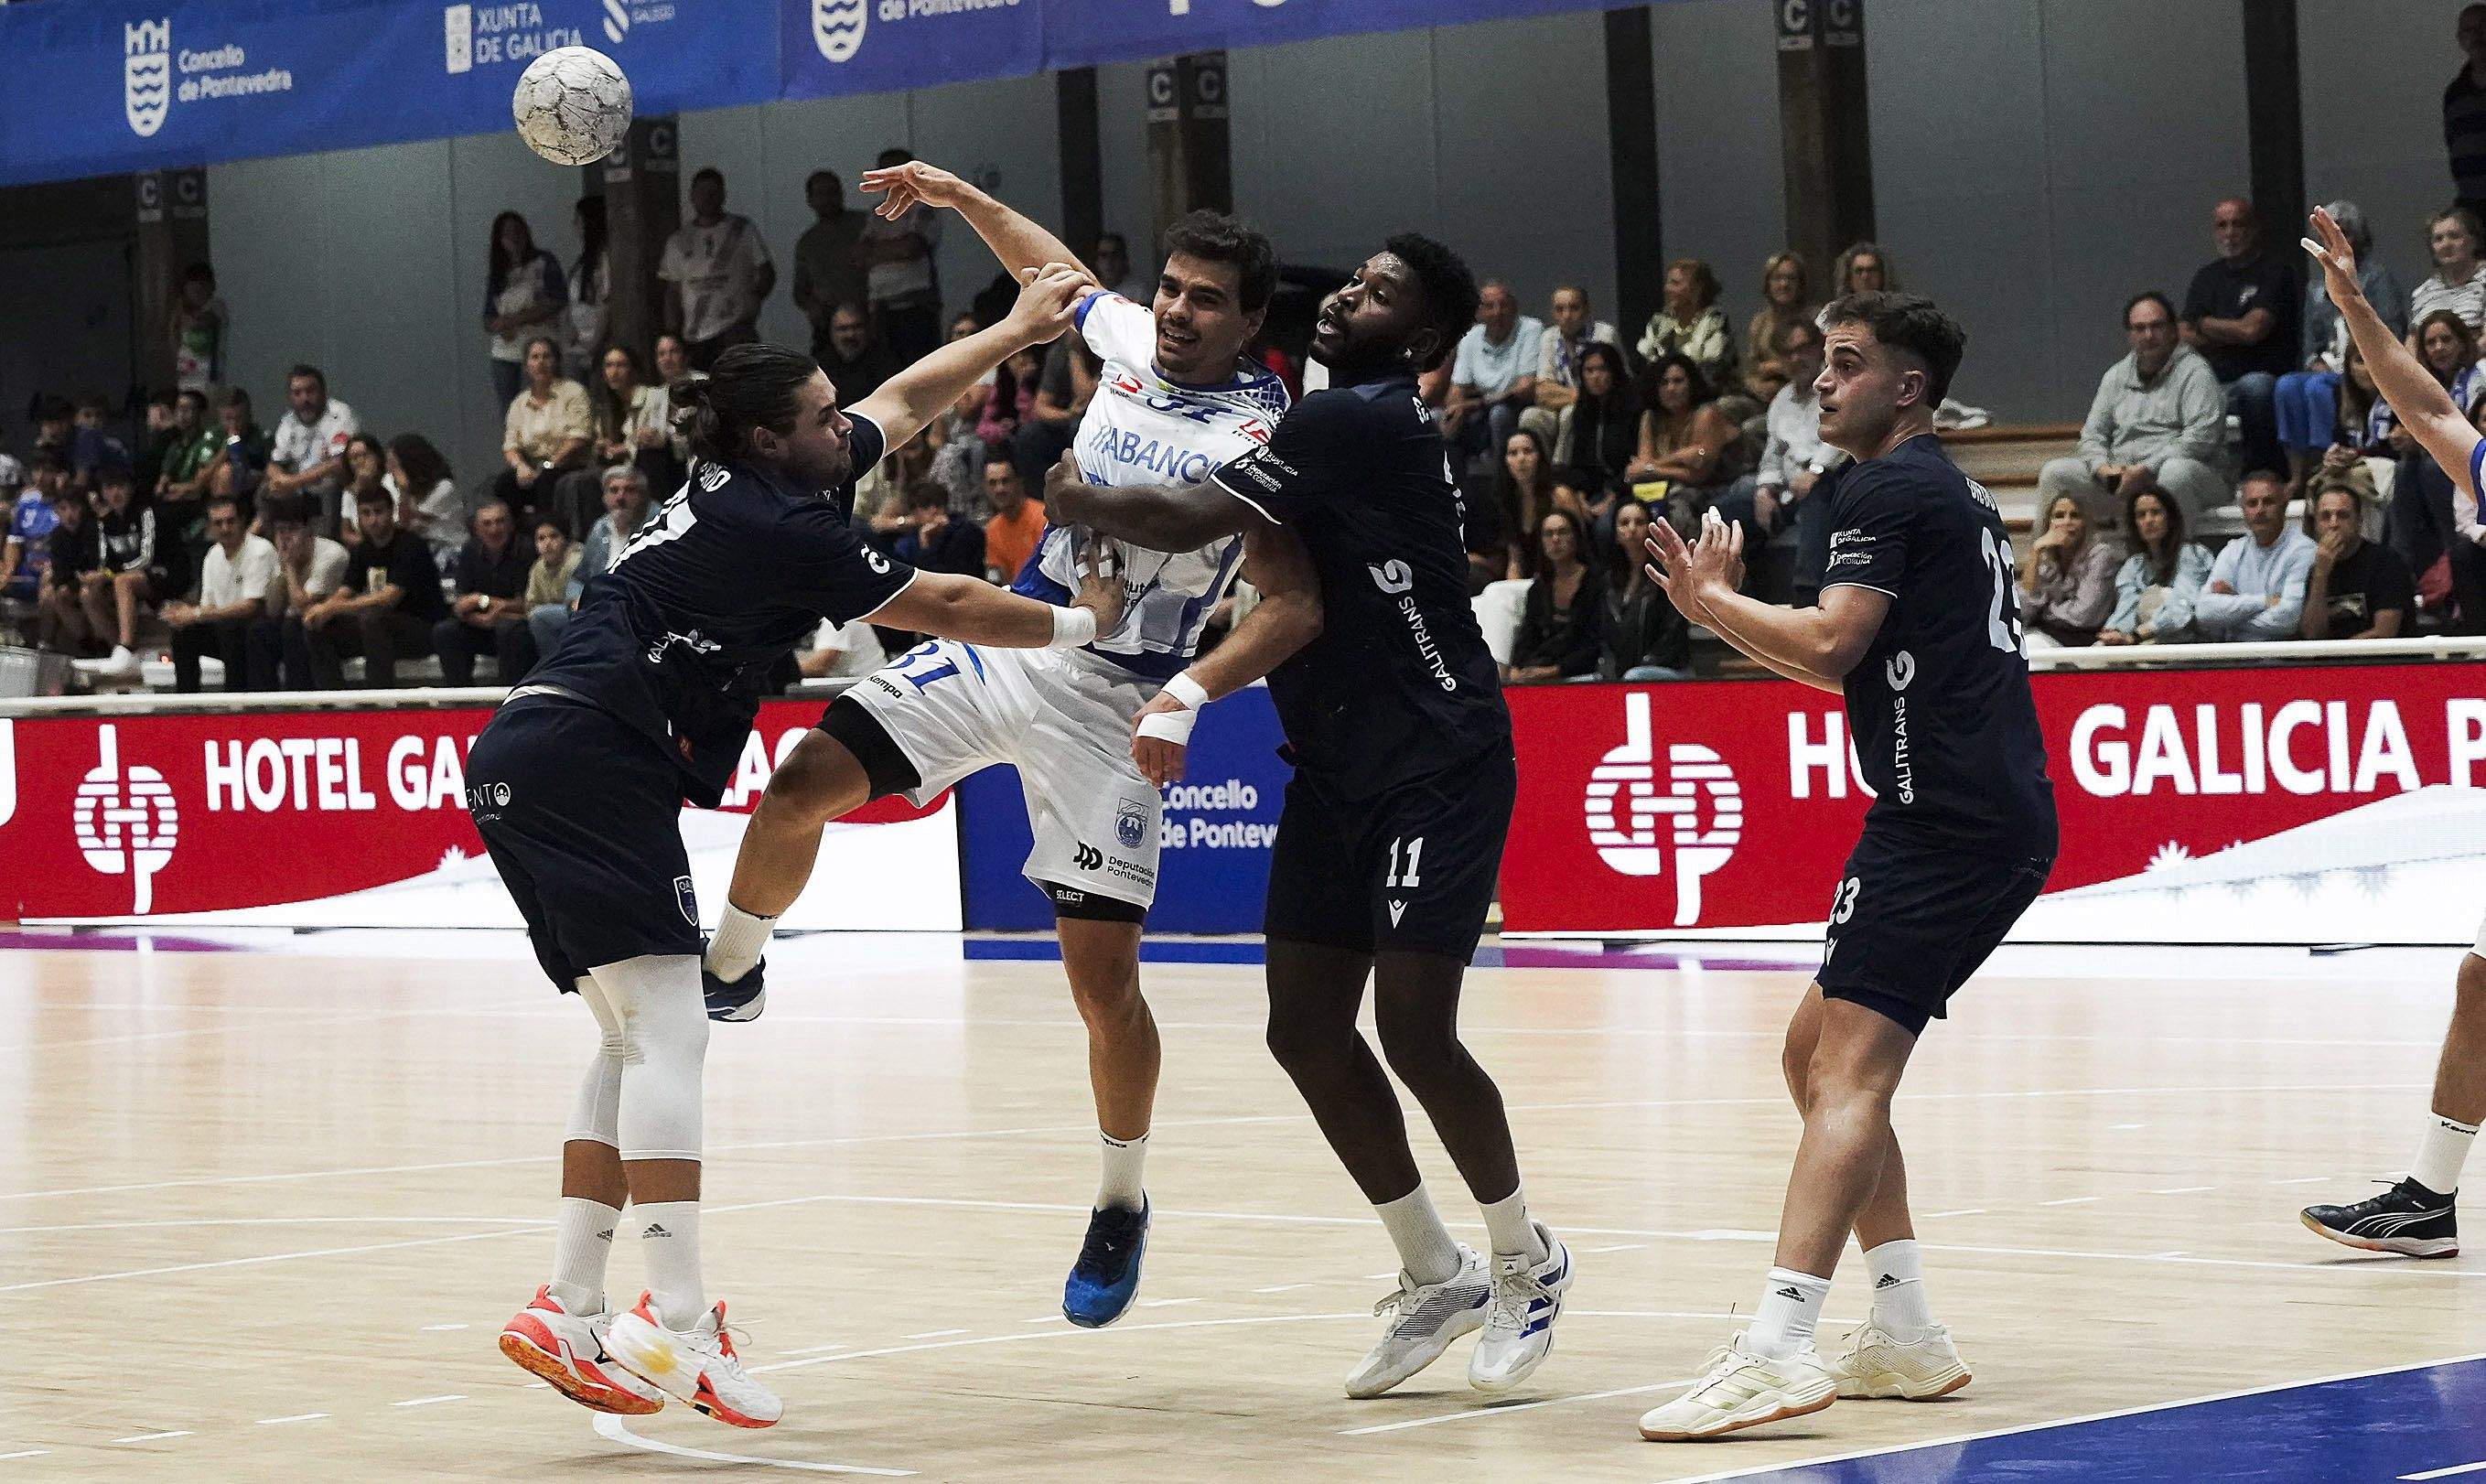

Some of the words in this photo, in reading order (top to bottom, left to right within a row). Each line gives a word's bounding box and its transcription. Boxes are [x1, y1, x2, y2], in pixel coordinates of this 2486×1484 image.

[477, 3, 543, 33] XUNTA
[476, 36, 503, 64] DE
[1151, 72, 1173, 103] C
[1398, 596, 1457, 692] GALITRANS
[1894, 696, 1914, 805] GALITRANS
[2069, 699, 2423, 798] GALICIA
[204, 737, 376, 812] HOTEL
[386, 735, 479, 811] GA
[1189, 817, 1279, 849] Pontev
[1386, 836, 1424, 887] 11
[1056, 889, 1085, 903] SELECT
